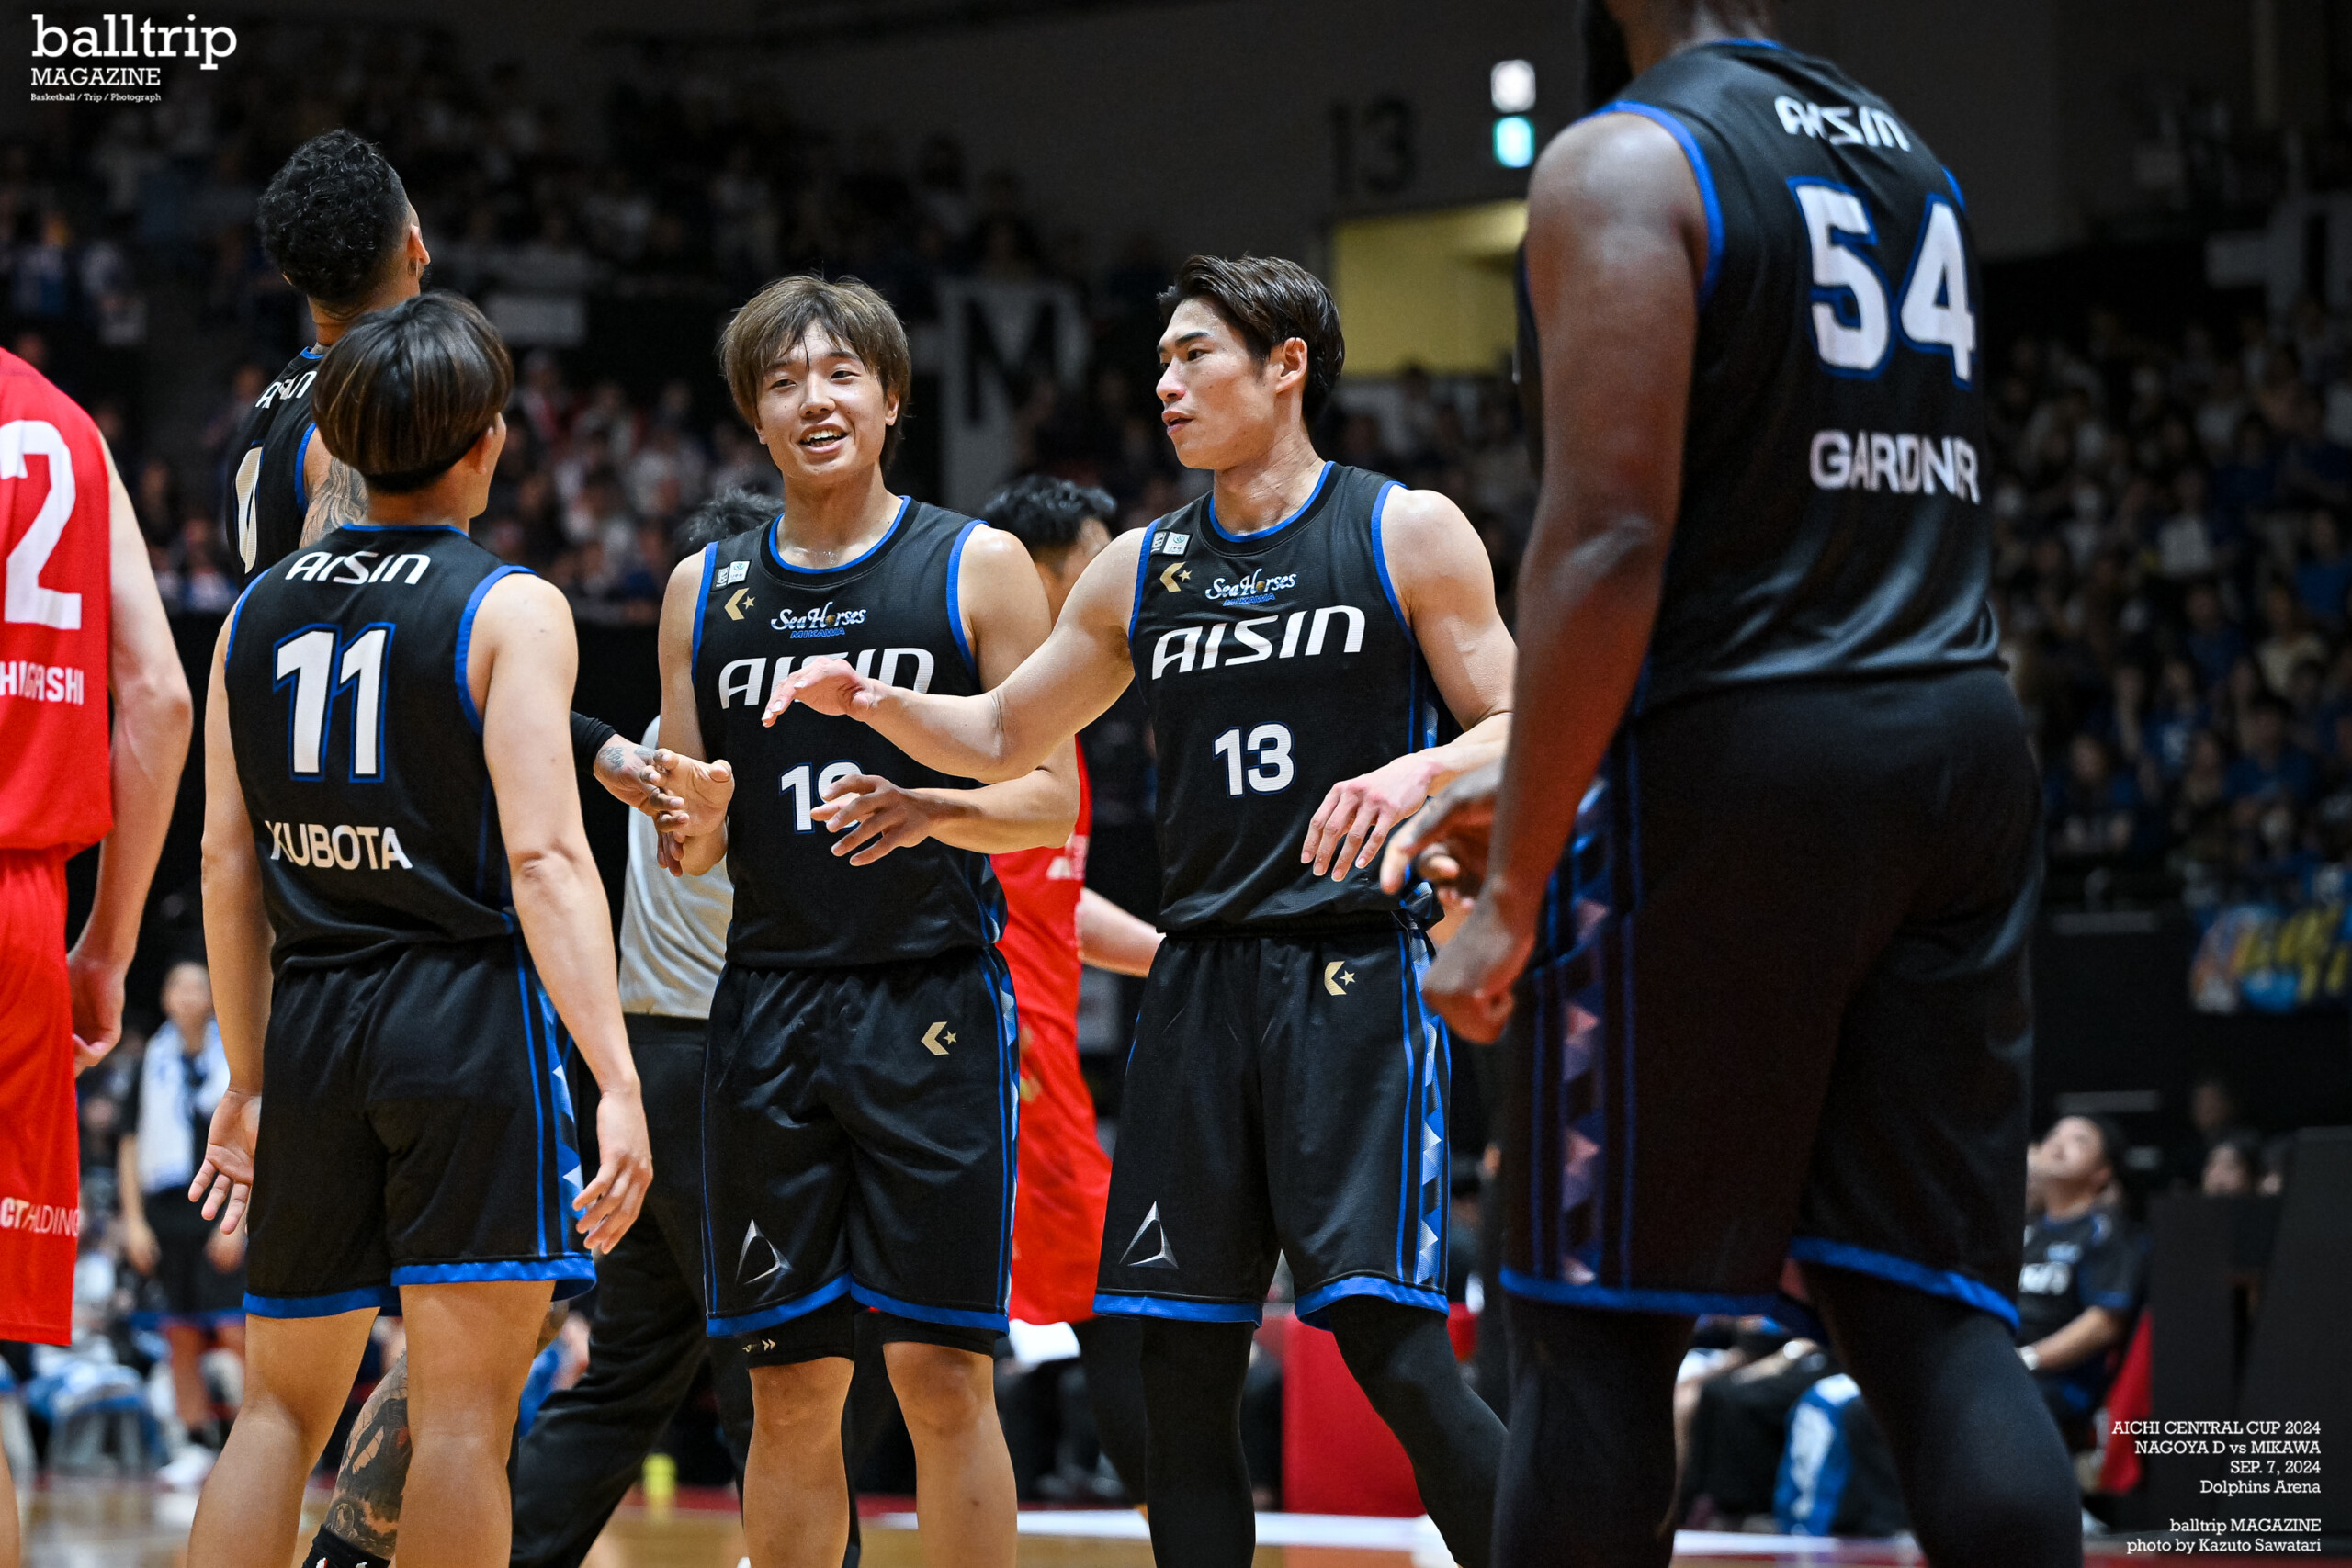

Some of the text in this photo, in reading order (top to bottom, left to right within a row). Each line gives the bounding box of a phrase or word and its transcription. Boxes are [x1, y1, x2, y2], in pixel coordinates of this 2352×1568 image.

[1774, 96, 1911, 152] AISIN
[1794, 184, 1977, 382] 54
[285, 550, 431, 585] AISIN
[790, 626, 845, 638] MIKAWA
[1152, 604, 1365, 680] AISIN
[276, 626, 389, 777] 11
[718, 647, 934, 709] AIIN
[1214, 721, 1295, 796] 13
